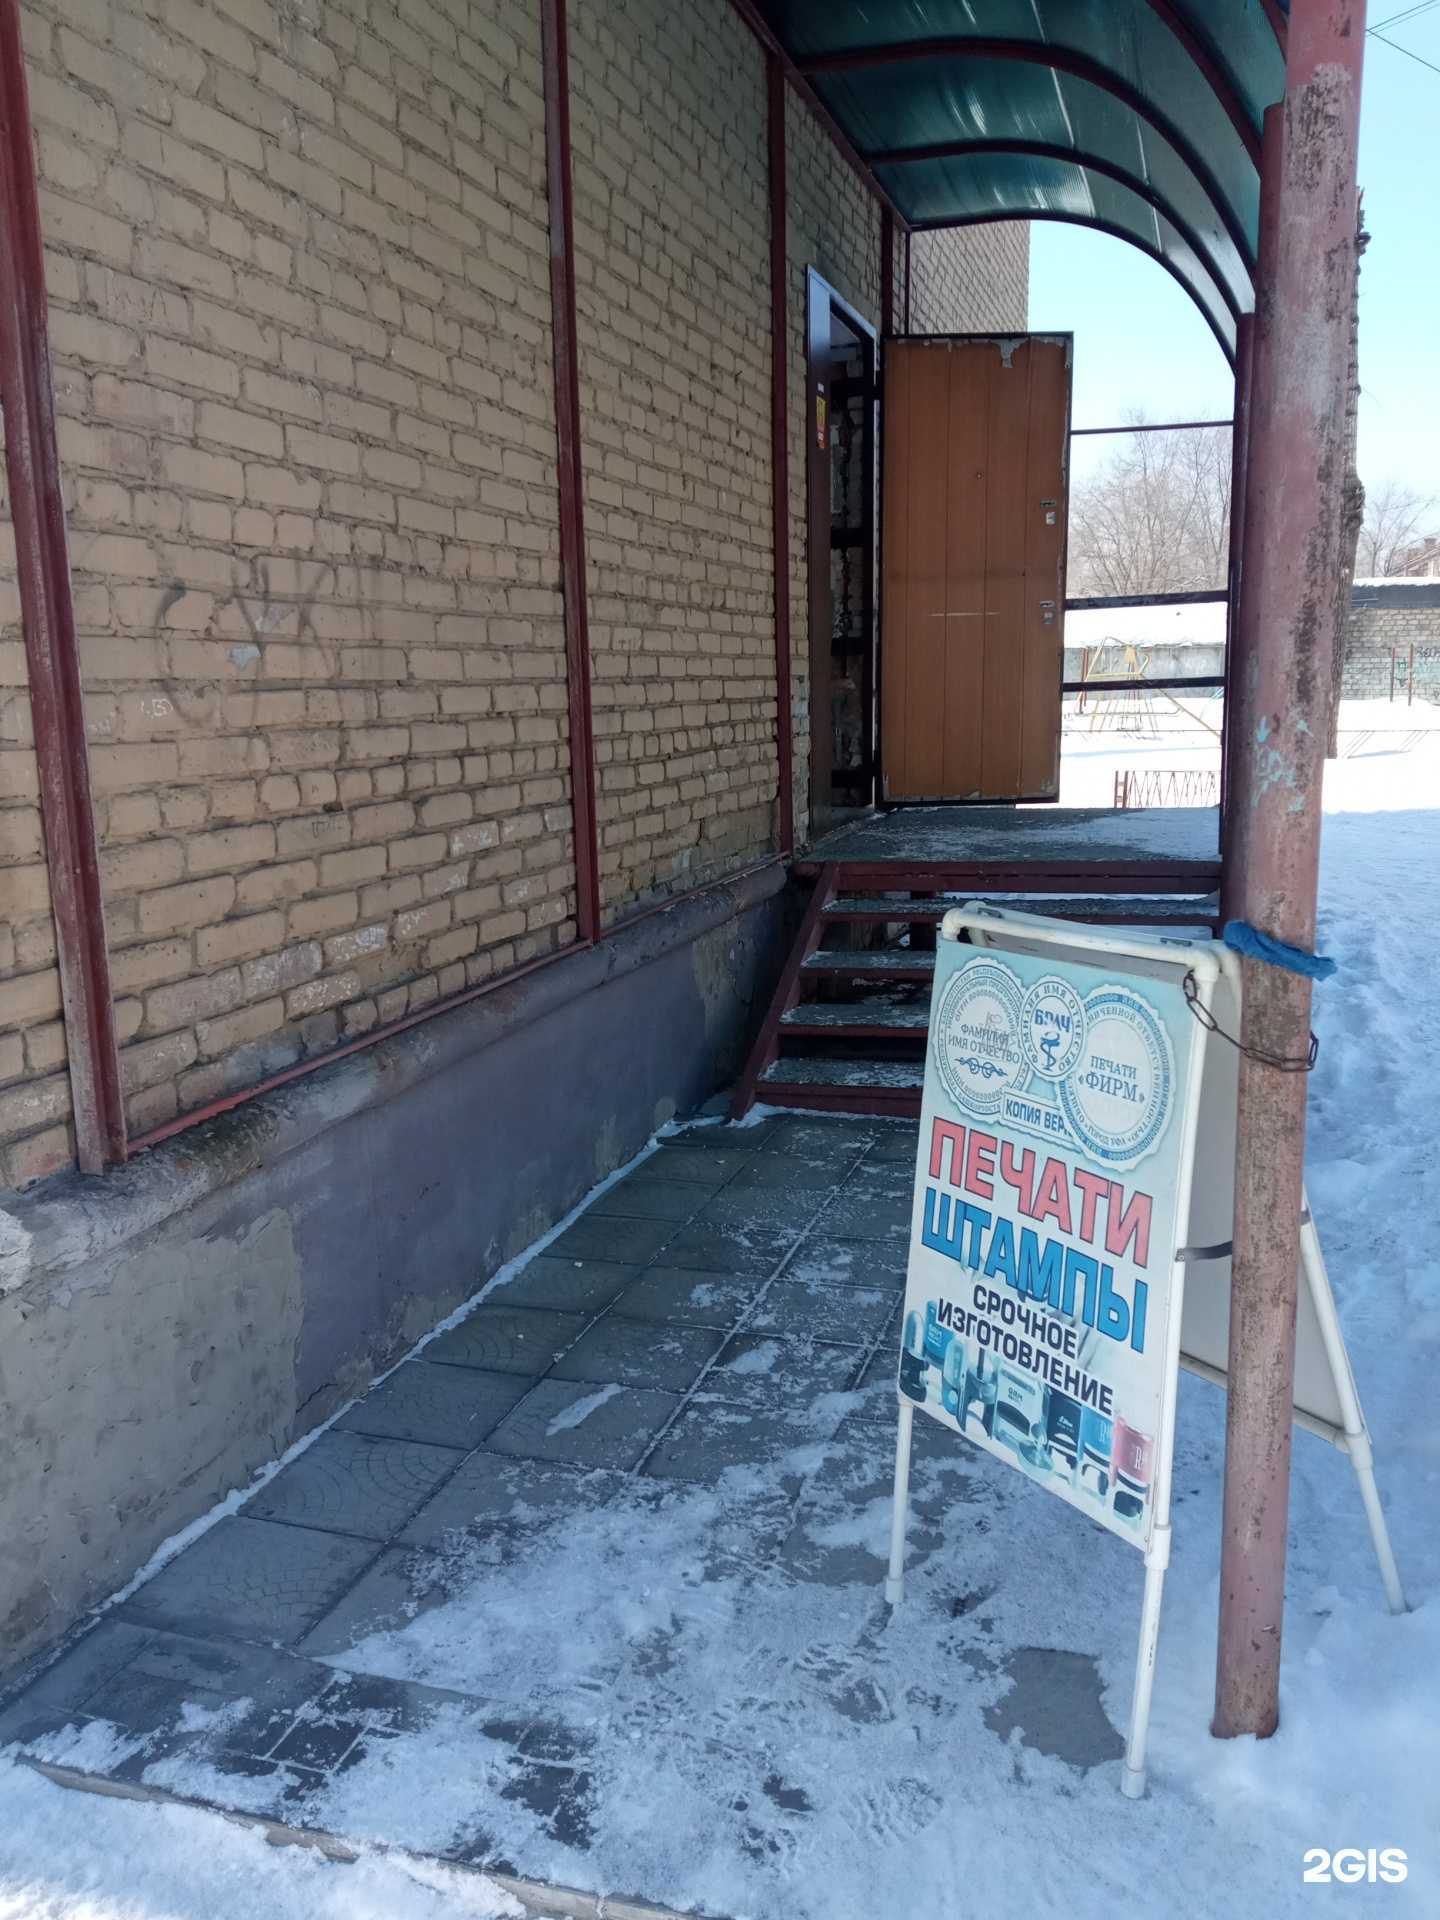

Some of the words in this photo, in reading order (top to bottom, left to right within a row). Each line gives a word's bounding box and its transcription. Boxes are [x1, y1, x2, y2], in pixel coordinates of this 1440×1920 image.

[1043, 984, 1067, 999] ИМЯ
[948, 1034, 968, 1050] ИМЯ
[1090, 1055, 1137, 1080] ПЕЧАТИ
[1005, 1099, 1041, 1126] КОПИЯ
[929, 1116, 1153, 1269] ПЕЧАТИ
[921, 1187, 1148, 1354] ШТАМПЫ
[973, 1284, 1077, 1359] СРОЧНОЕ
[937, 1298, 1113, 1416] ИЗГОТОВЛЕНИЕ
